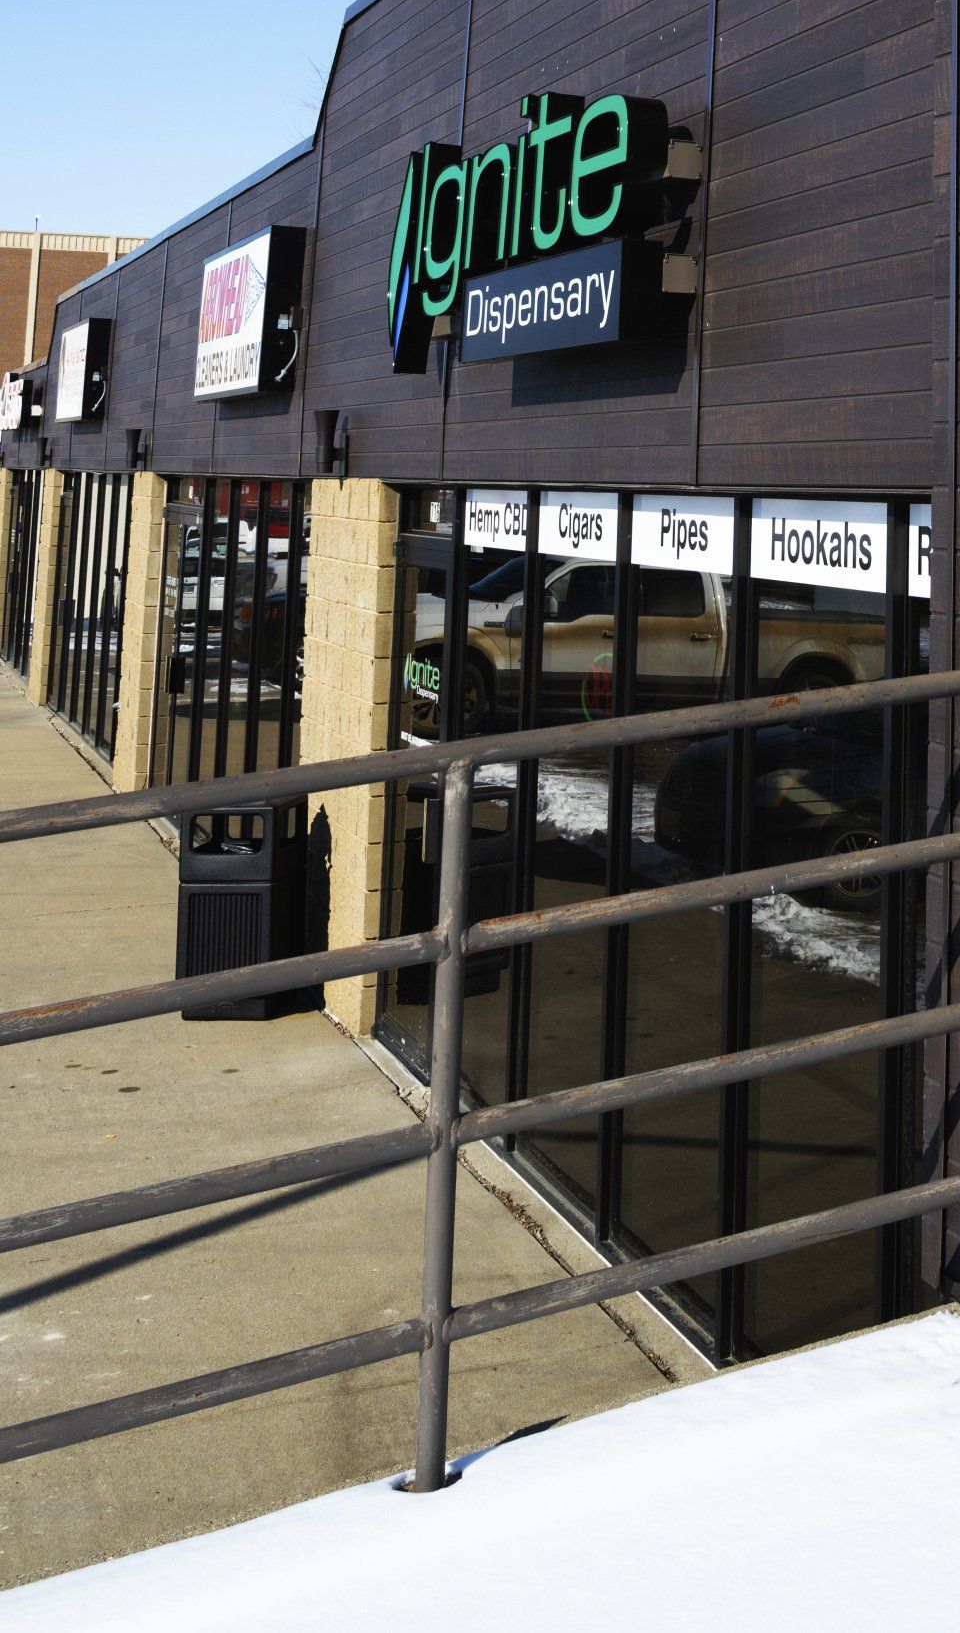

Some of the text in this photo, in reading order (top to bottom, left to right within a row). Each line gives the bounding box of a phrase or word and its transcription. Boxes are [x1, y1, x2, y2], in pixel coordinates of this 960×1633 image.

[412, 91, 629, 317] Ignite
[465, 269, 615, 344] Dispensary
[196, 351, 223, 388] CLEANERS
[229, 341, 261, 382] LAUNDRY
[469, 500, 500, 543] Hemp
[559, 502, 603, 549] Cigars
[660, 508, 709, 559] Pipes
[771, 517, 873, 572] Hookahs
[408, 652, 440, 691] Ignite
[416, 685, 439, 704] Dispensary
